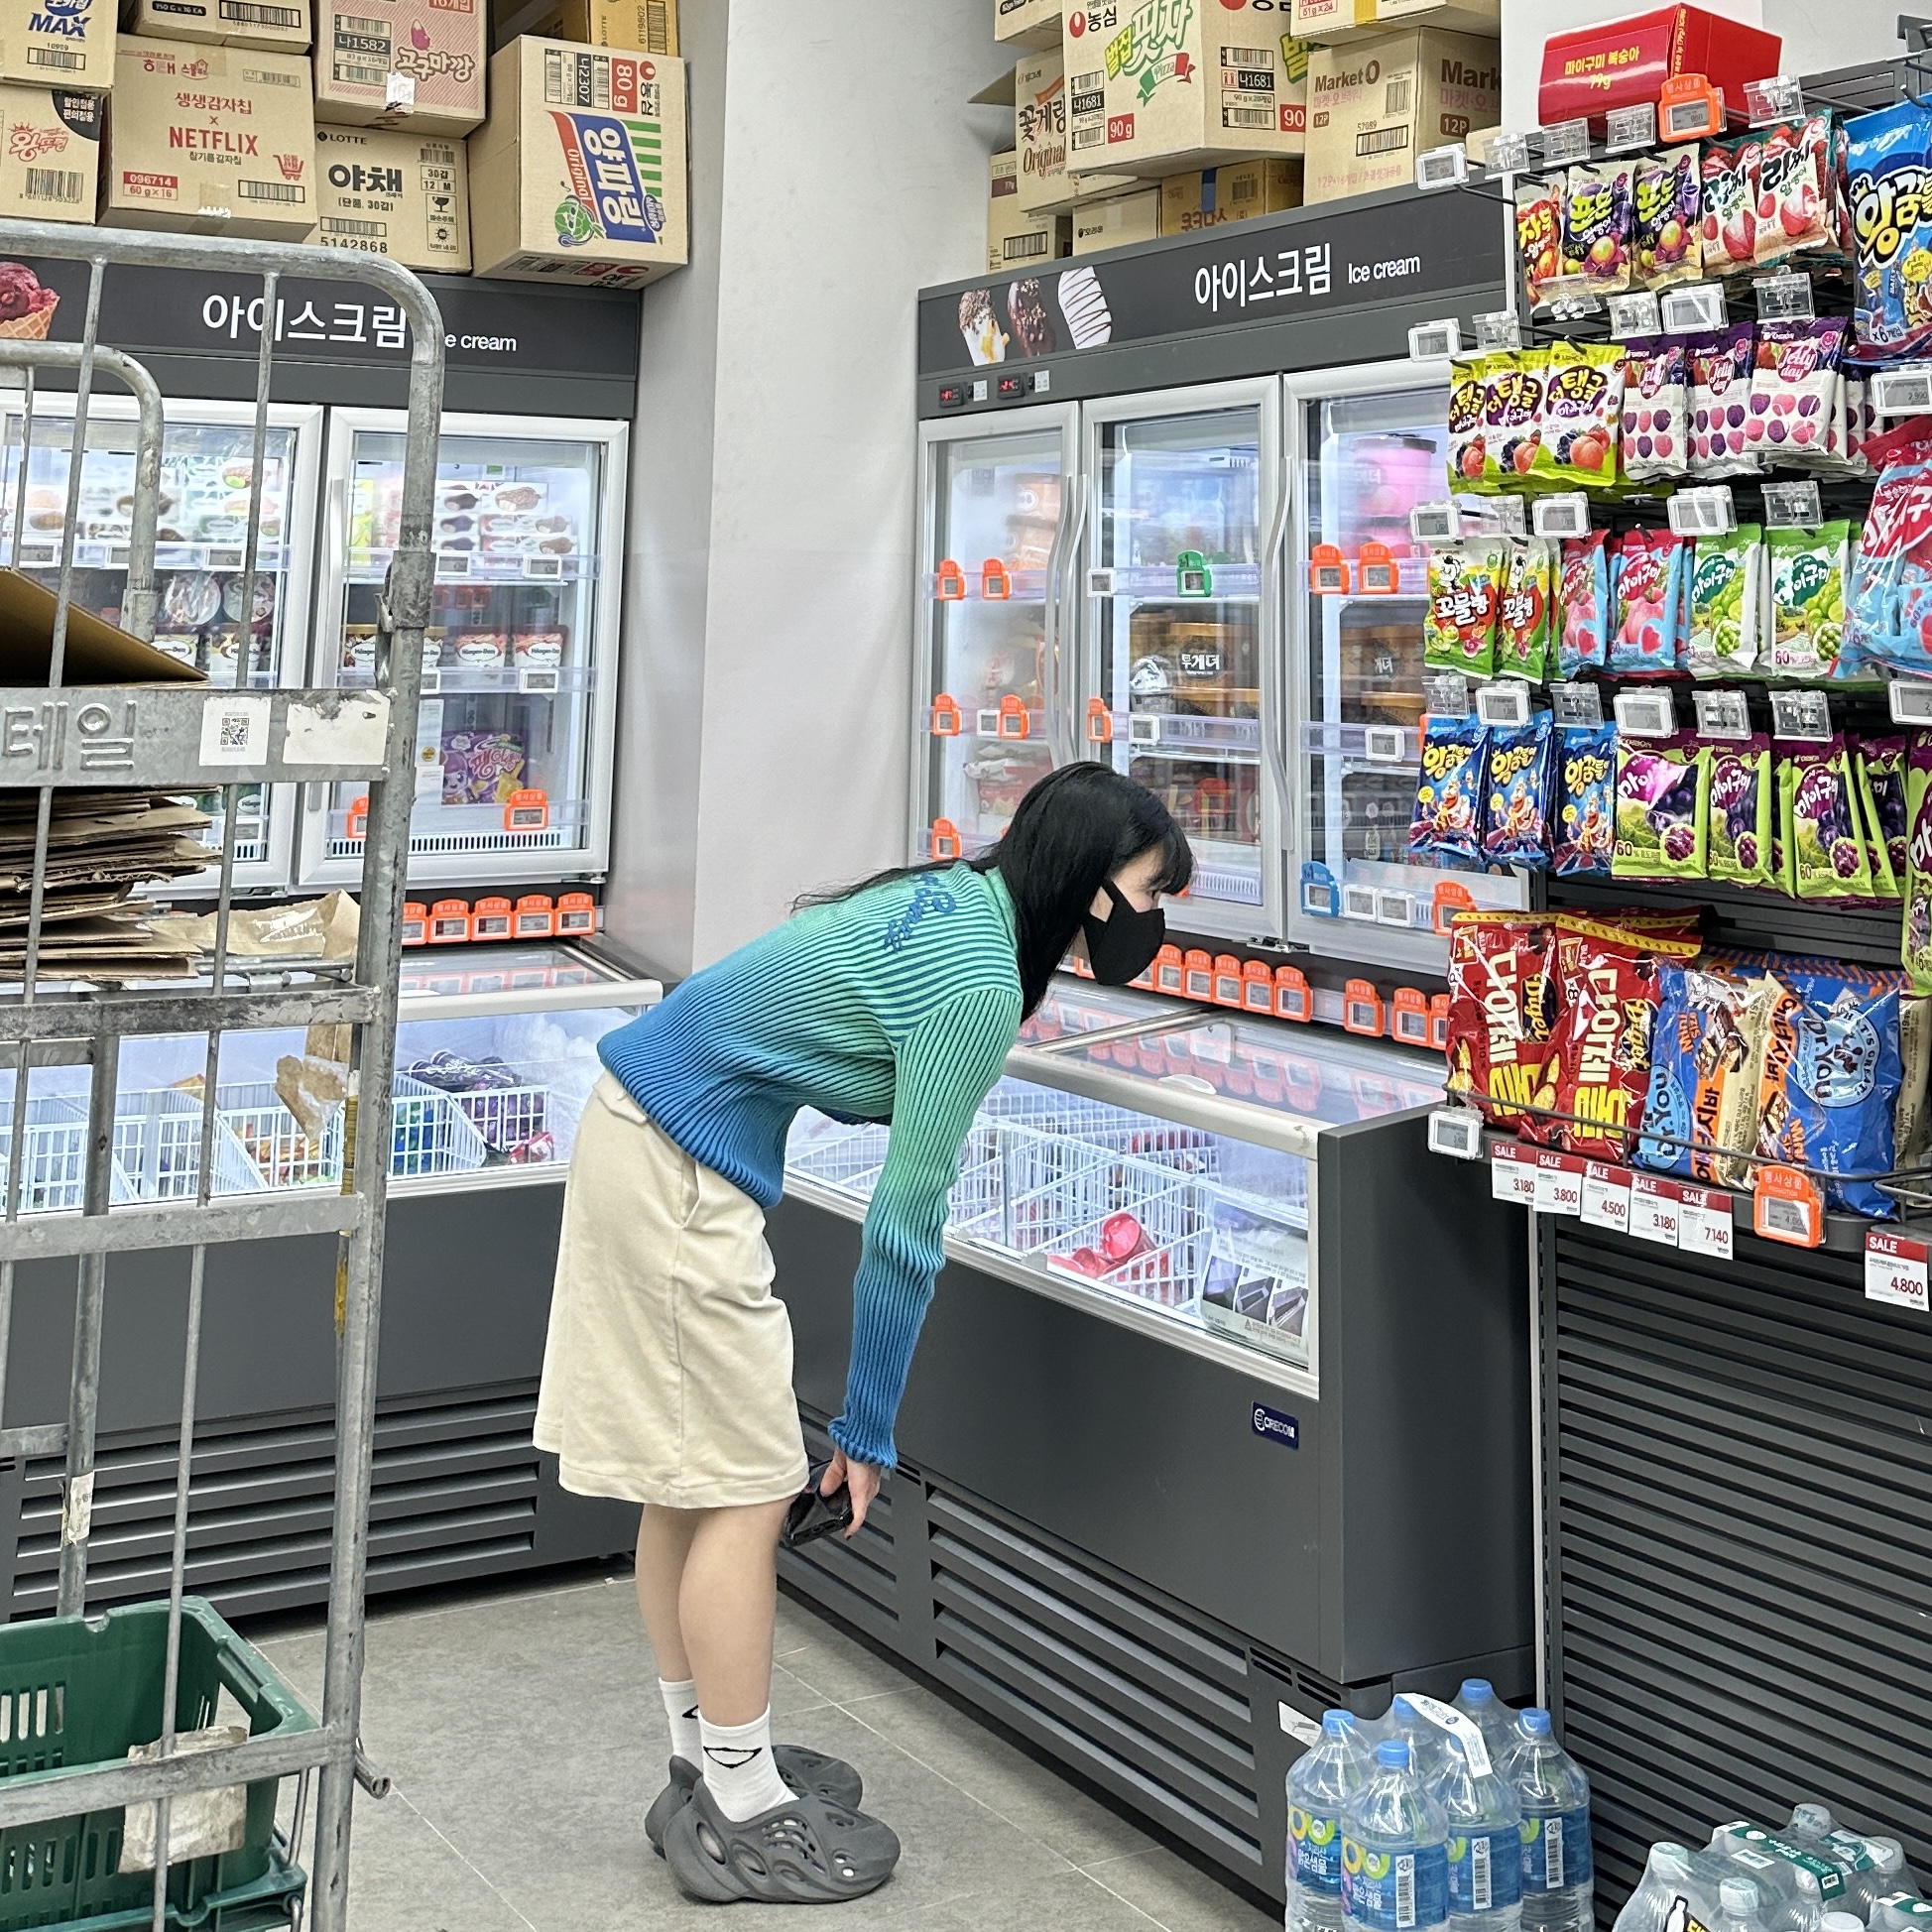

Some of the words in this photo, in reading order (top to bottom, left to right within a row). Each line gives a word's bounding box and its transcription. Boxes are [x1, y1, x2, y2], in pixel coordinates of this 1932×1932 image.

[28, 12, 91, 38] MAX
[1087, 5, 1117, 33] 농심
[338, 36, 387, 52] 나1582
[395, 47, 476, 82] 고구마깡
[1565, 55, 1606, 76] 마이구미
[1608, 46, 1640, 66] 복숭아
[578, 58, 590, 103] 나2307
[616, 63, 634, 91] 80
[1240, 74, 1272, 88] 나1681
[1315, 68, 1364, 92] Market
[1365, 60, 1381, 85] O
[1441, 60, 1502, 91] Mark
[1590, 74, 1612, 90] 79g
[175, 92, 252, 115] 생생감자칩
[613, 94, 629, 108] g
[641, 82, 654, 116] 농심
[1073, 95, 1102, 113] 나1681
[1110, 119, 1123, 139] 90
[1125, 122, 1133, 139] g
[1283, 108, 1305, 128] 90
[1315, 113, 1328, 127] 12P
[1444, 117, 1468, 135] 12P
[169, 126, 259, 157] NETFLIX
[330, 134, 368, 145] LOTTE
[566, 148, 593, 202] Original
[583, 127, 646, 227] 양파링
[1761, 140, 1811, 192] 리찌
[130, 185, 143, 195] 60
[328, 164, 403, 193] 야채
[1637, 175, 1676, 223] 포도
[1569, 189, 1614, 233] 포도
[320, 236, 388, 254] 5142868
[1194, 243, 1331, 312] 아이스크림
[1347, 261, 1371, 285] Ice
[1373, 253, 1421, 279] cream
[202, 293, 407, 351] 아이스크림
[459, 332, 518, 353] cream
[1778, 346, 1817, 371] Jelly
[1710, 360, 1735, 383] Jelly
[1780, 365, 1804, 381] day
[1618, 562, 1661, 600] 마이구미
[1692, 564, 1735, 603] 마이구미
[1180, 653, 1220, 671] 투게더
[1775, 651, 1790, 665] 60
[1711, 770, 1751, 807] 마이구미
[1793, 776, 1839, 818] 마이구미
[1617, 841, 1633, 857] 60
[1799, 863, 1813, 881] 60
[1495, 1146, 1516, 1159] SALE
[1539, 1153, 1562, 1168] SALE
[1635, 1176, 1657, 1192] SALE
[1764, 1171, 1802, 1189] 행사상품
[1682, 1189, 1707, 1207] SALE
[1869, 1236, 1898, 1254] SALE
